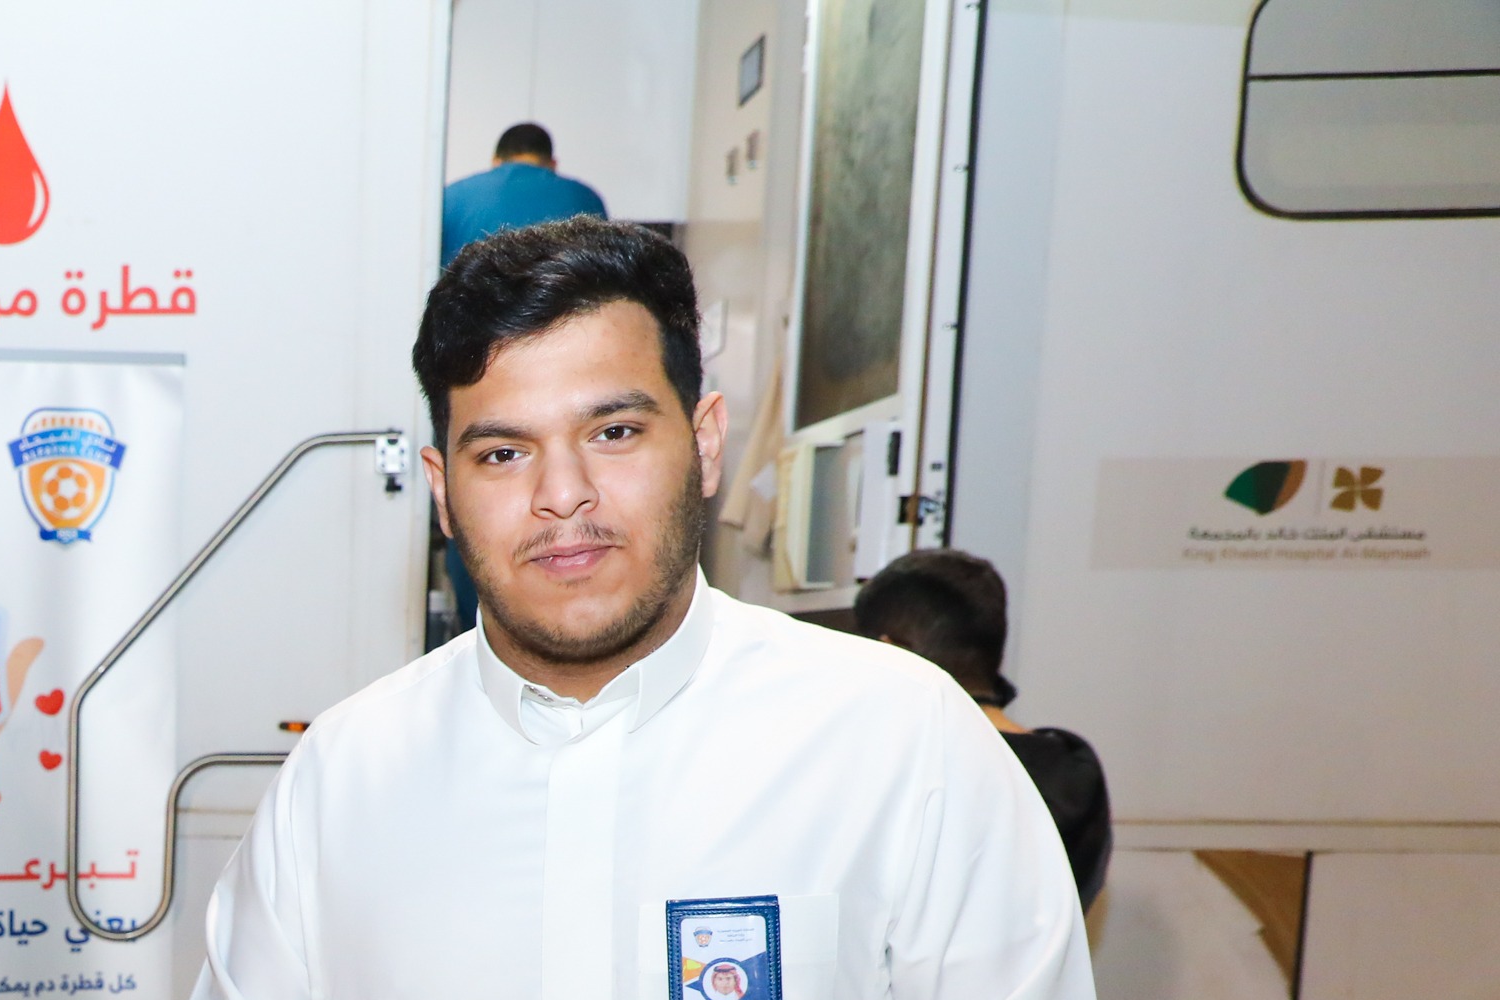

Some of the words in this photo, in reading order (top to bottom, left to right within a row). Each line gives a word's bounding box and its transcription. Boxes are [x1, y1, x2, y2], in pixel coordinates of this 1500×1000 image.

[61, 264, 197, 331] قطرة
[33, 979, 56, 998] دم
[59, 971, 105, 996] قطرة
[108, 973, 137, 995] كل
